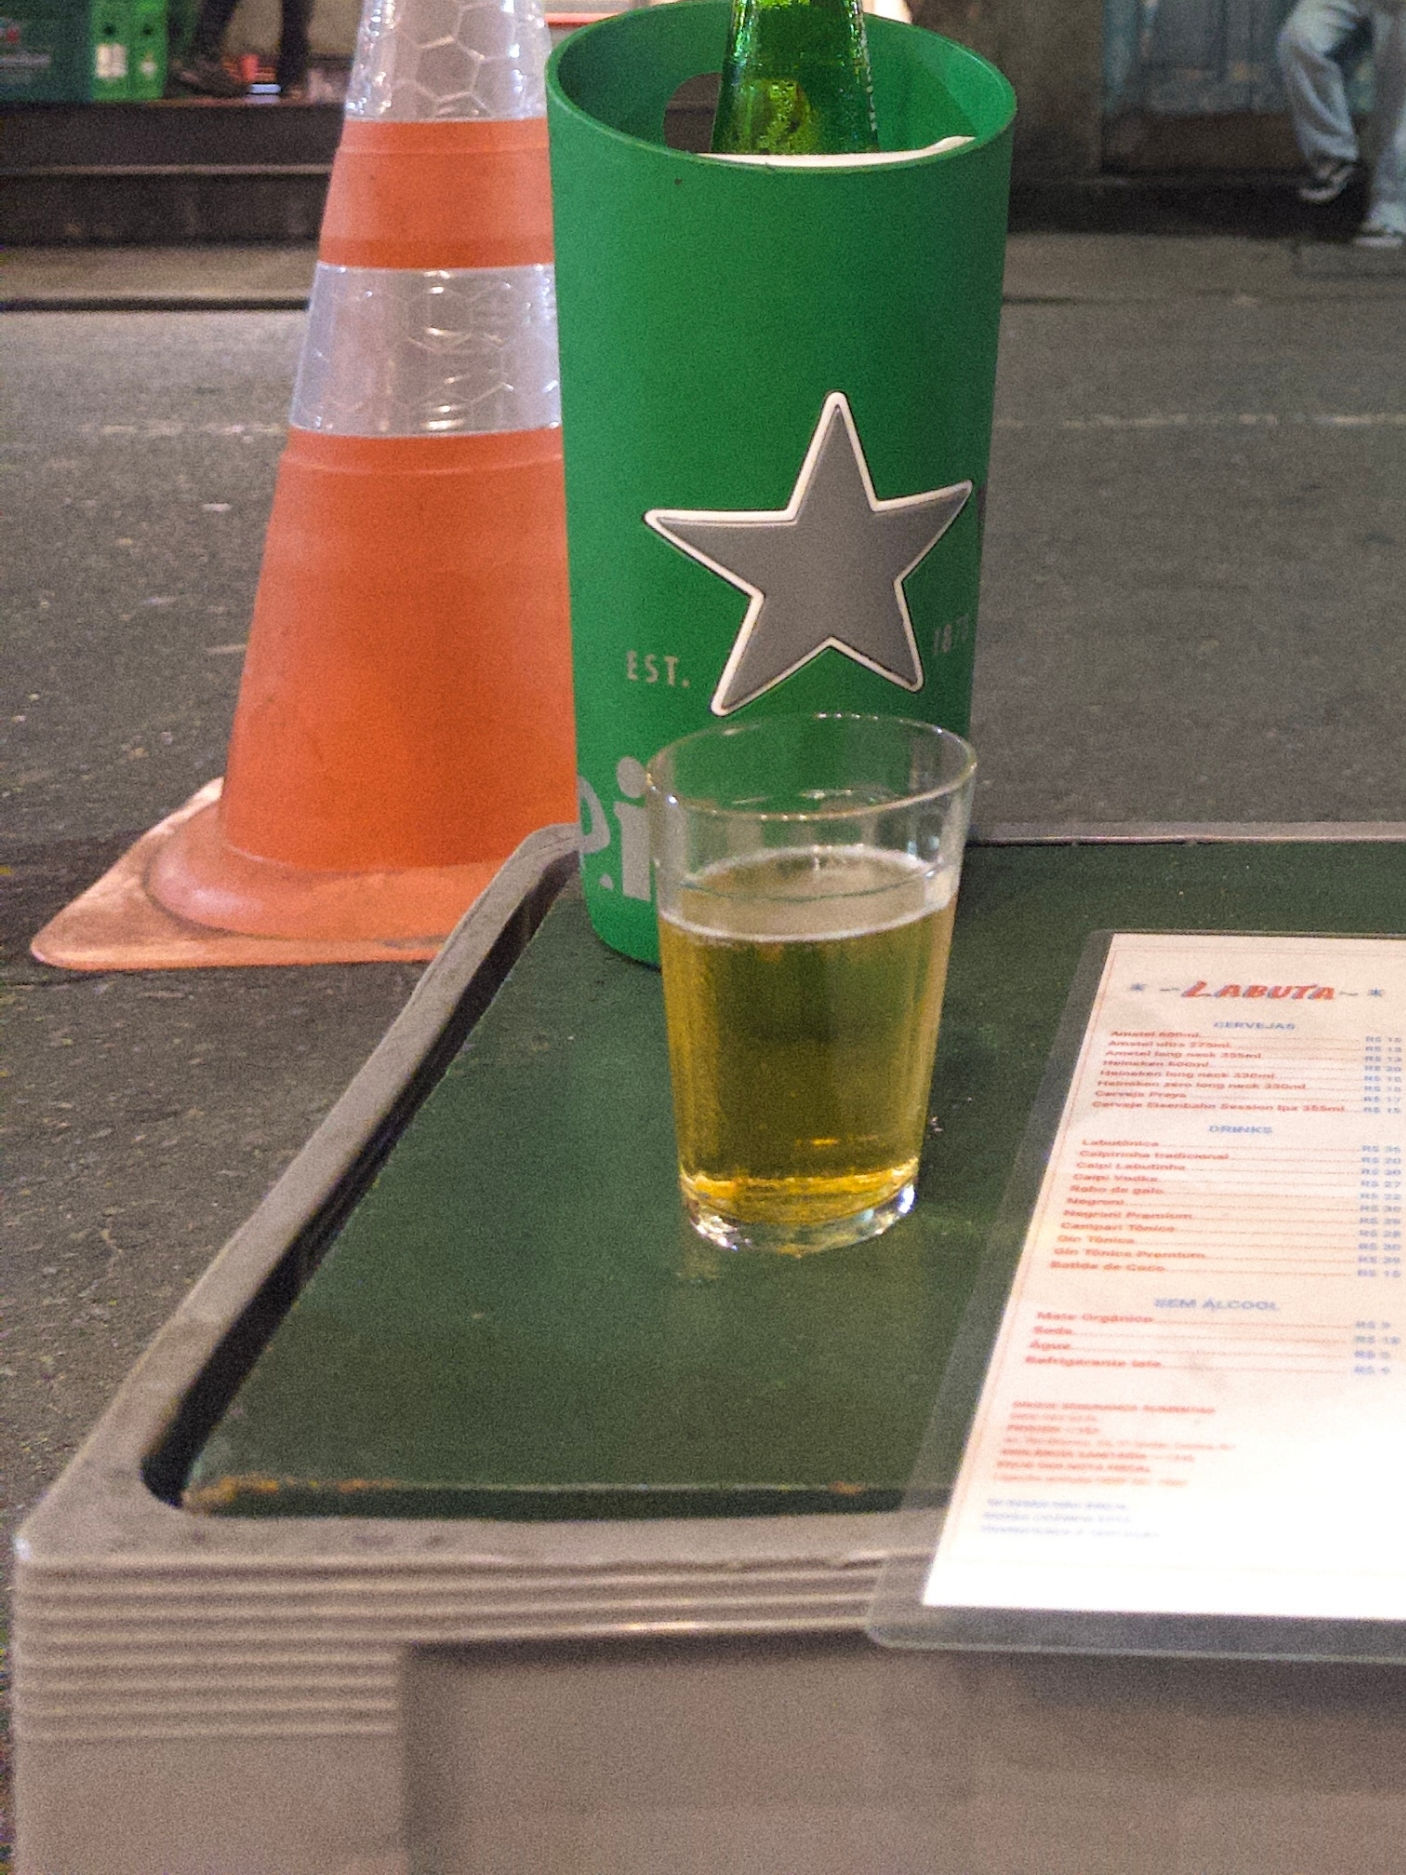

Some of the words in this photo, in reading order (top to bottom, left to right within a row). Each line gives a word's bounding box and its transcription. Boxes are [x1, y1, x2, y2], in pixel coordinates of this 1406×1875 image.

[626, 649, 691, 689] EST.
[1180, 980, 1335, 1000] LABUTA
[1212, 1021, 1296, 1030] CERVEJAS
[1154, 1051, 1183, 1059] long
[1186, 1051, 1216, 1059] neck
[1102, 1060, 1164, 1068] Heineken
[1100, 1069, 1162, 1078] Heineken
[1165, 1071, 1194, 1079] long
[1197, 1071, 1229, 1079] neck
[1097, 1079, 1160, 1087] Heineken
[1196, 1081, 1225, 1090] long
[1227, 1082, 1260, 1090] neck
[1146, 1101, 1216, 1110] Eisenbahn
[1208, 1125, 1273, 1135] DRINKS
[1077, 1161, 1112, 1170] Caipi
[1073, 1173, 1110, 1182] Caipi
[1111, 1186, 1129, 1194] de
[1066, 1197, 1125, 1207] Negroni
[1062, 1209, 1121, 1219] Negroni
[1060, 1222, 1123, 1232] Campari
[1102, 1262, 1121, 1271] de
[1152, 1297, 1198, 1309] SEM
